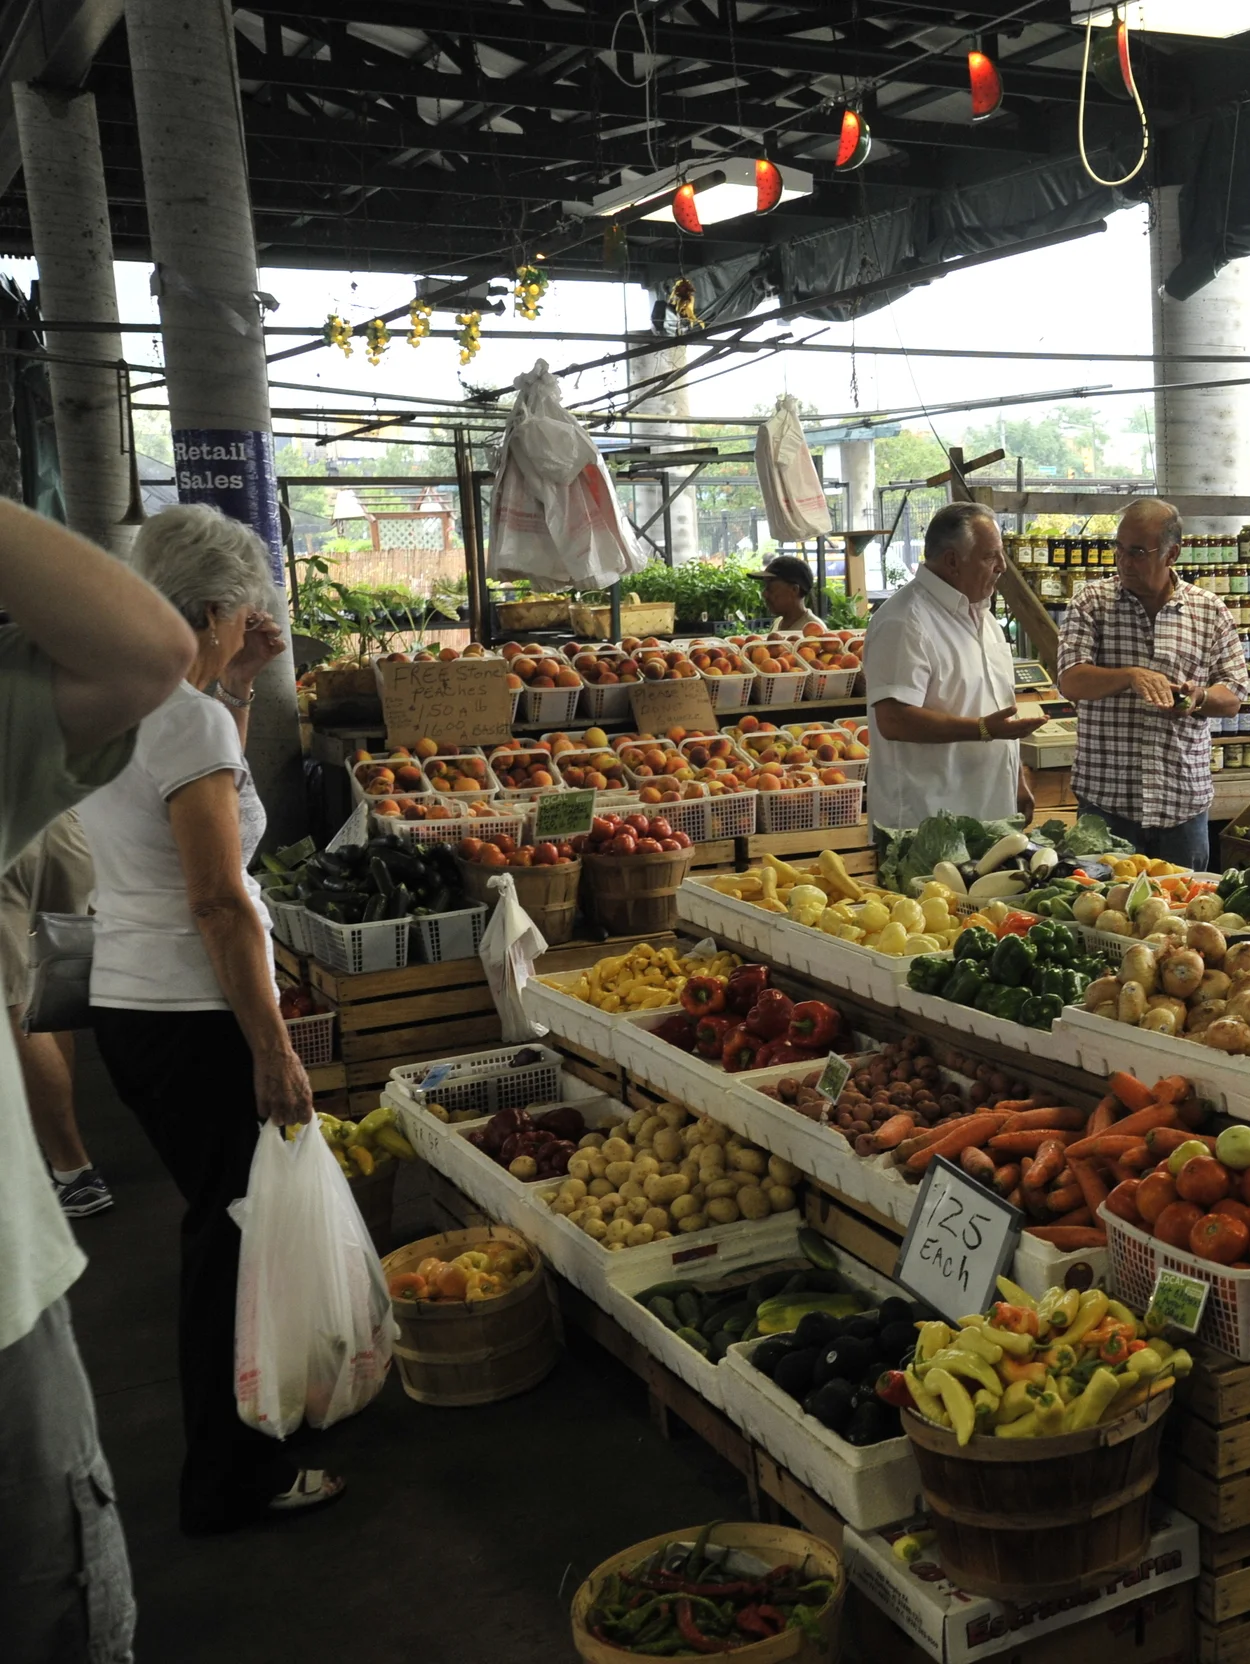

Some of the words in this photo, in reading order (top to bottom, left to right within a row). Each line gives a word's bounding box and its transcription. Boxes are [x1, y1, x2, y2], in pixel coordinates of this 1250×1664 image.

[175, 442, 247, 461] Retail
[179, 471, 244, 490] Sales
[394, 665, 451, 691] FREE
[538, 794, 569, 807] LOCAL
[1159, 1274, 1186, 1287] LOCAL
